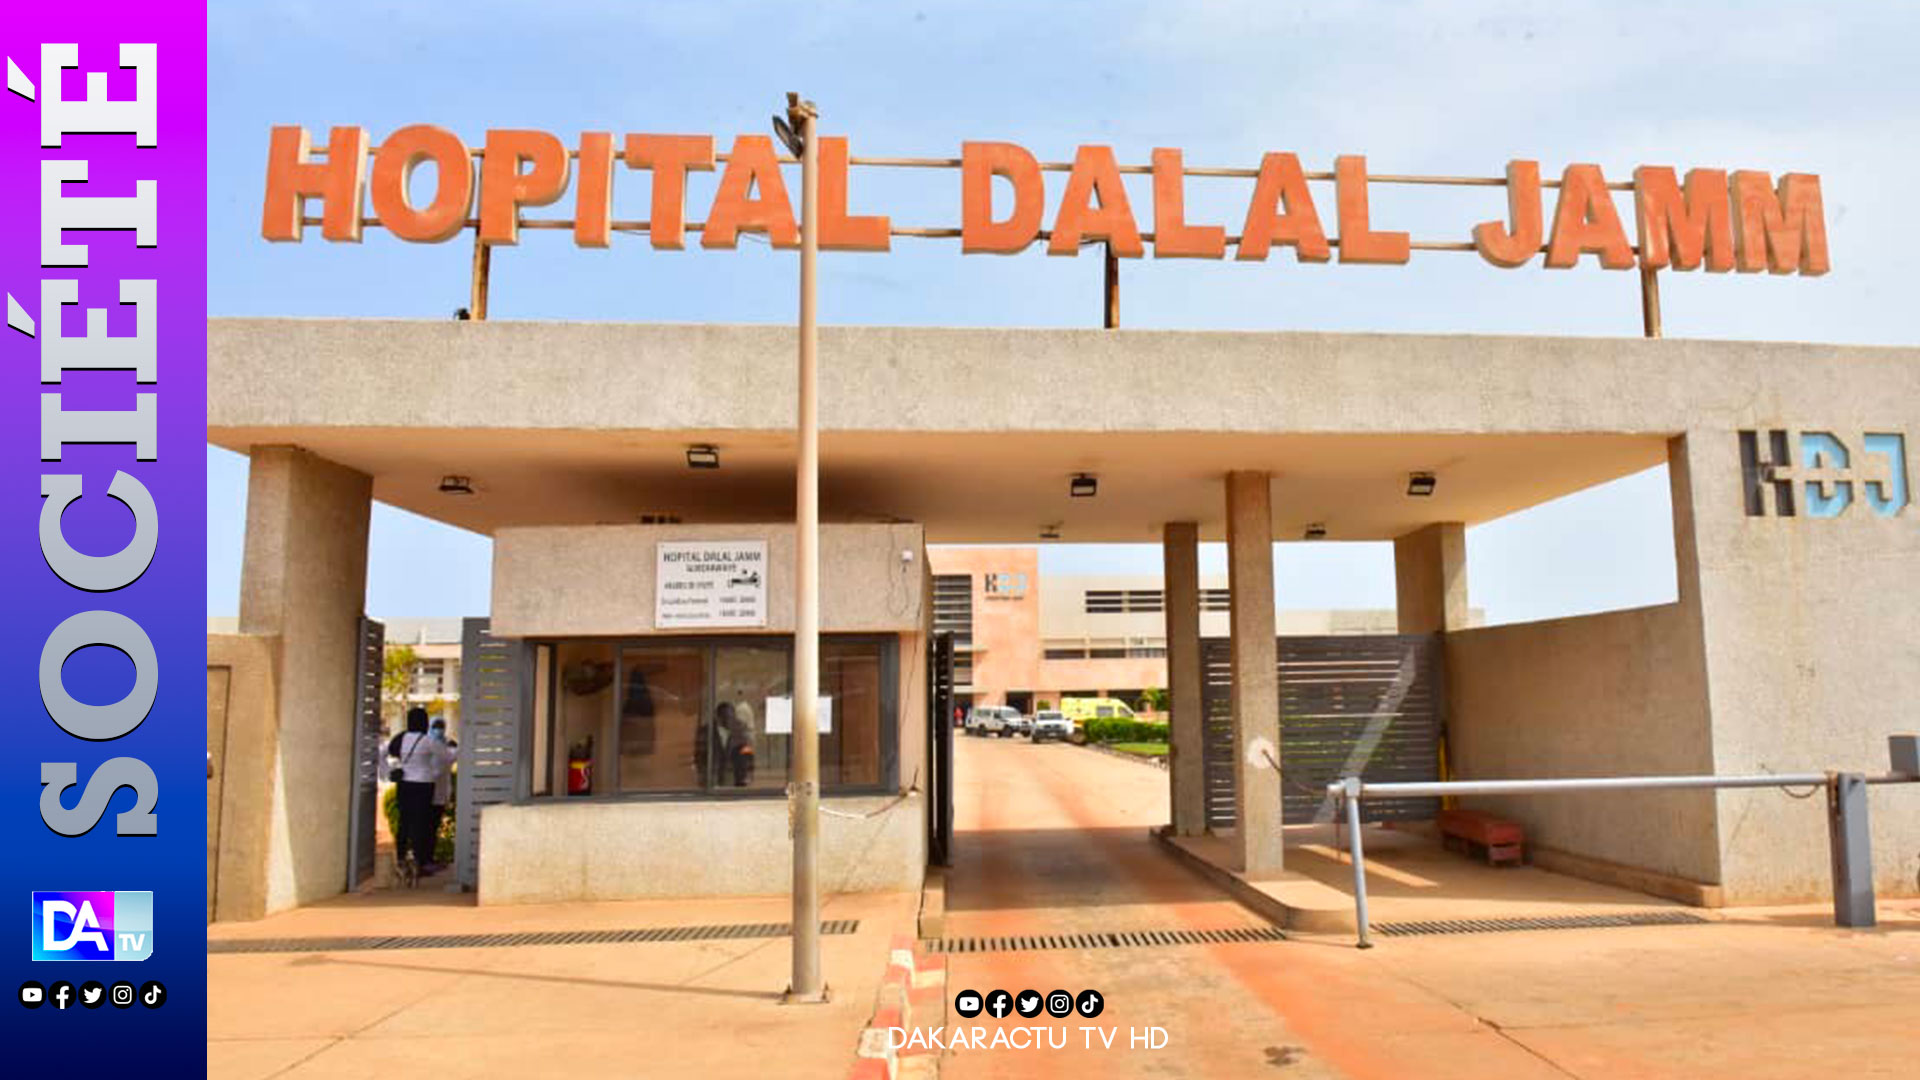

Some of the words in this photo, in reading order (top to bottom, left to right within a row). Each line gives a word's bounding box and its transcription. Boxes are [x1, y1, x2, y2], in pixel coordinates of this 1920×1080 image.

[262, 124, 890, 251] HOPITAL
[962, 141, 1409, 265] DALAL
[1472, 160, 1830, 276] JAMM
[1738, 430, 1910, 518] HDJ
